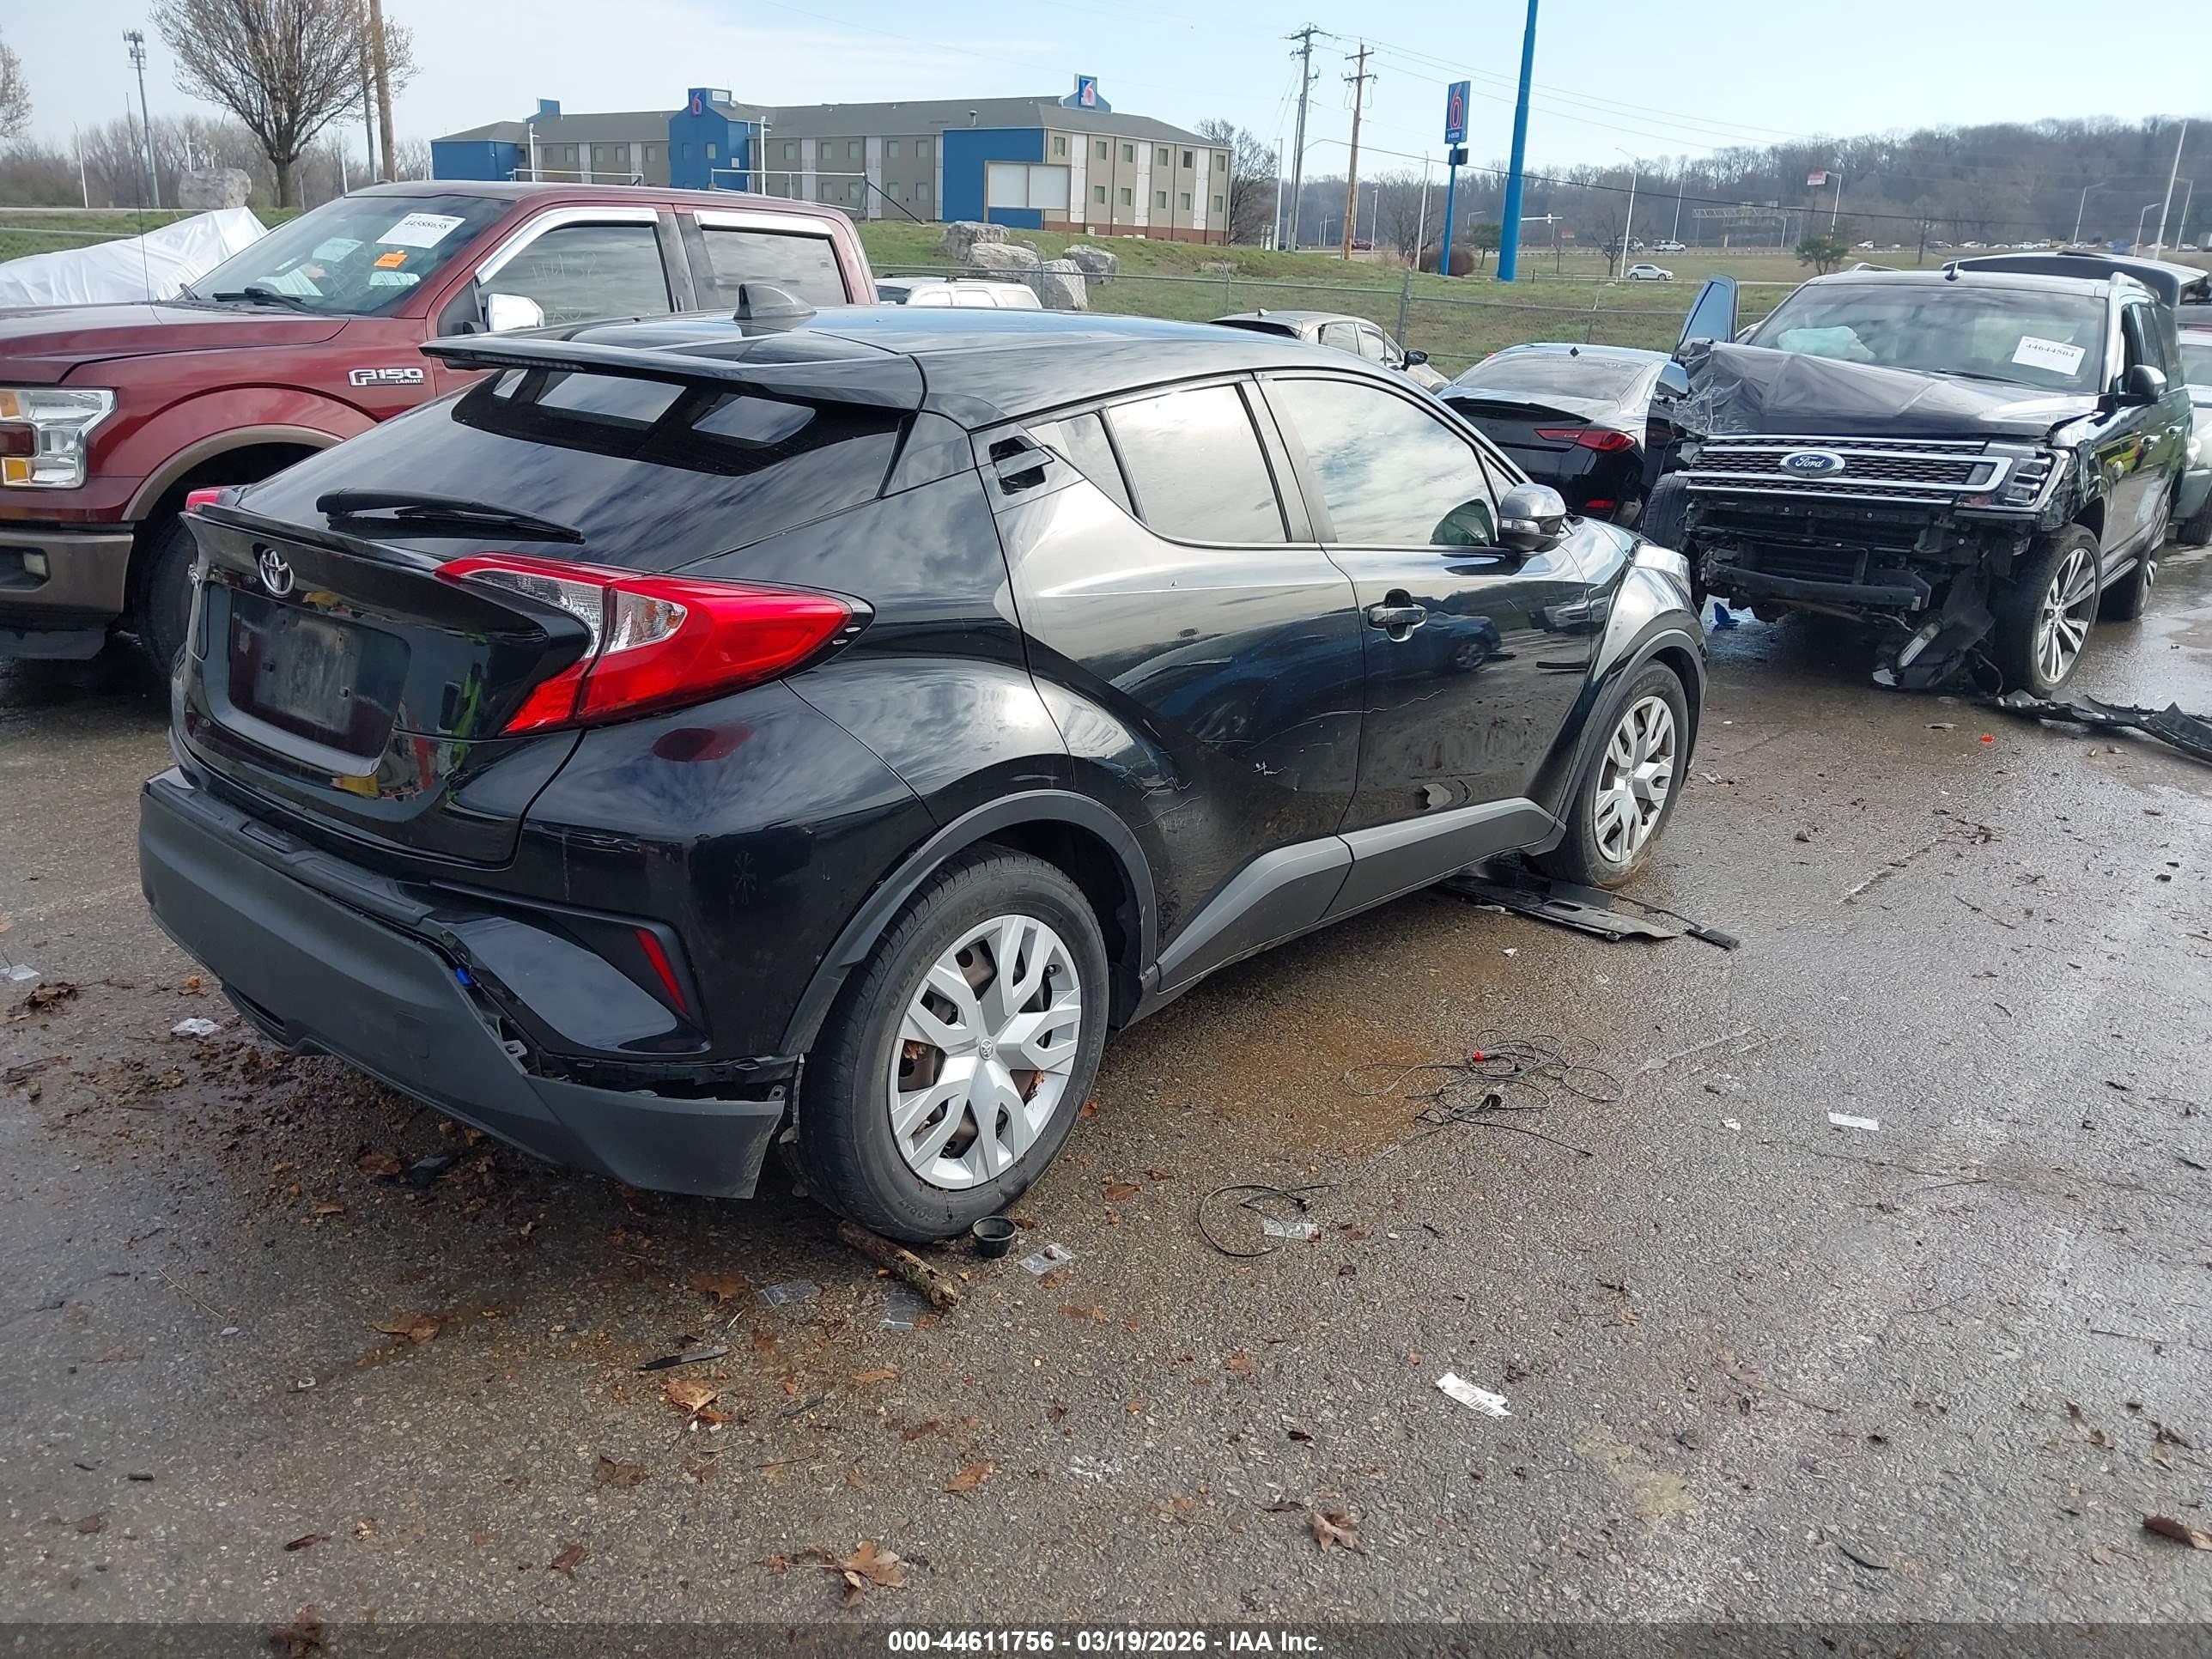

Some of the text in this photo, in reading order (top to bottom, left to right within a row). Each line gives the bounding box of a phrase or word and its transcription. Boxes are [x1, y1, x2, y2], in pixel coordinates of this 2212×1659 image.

[691, 92, 702, 115] 6
[1450, 83, 1462, 129] 6
[1795, 455, 1826, 468] Ford
